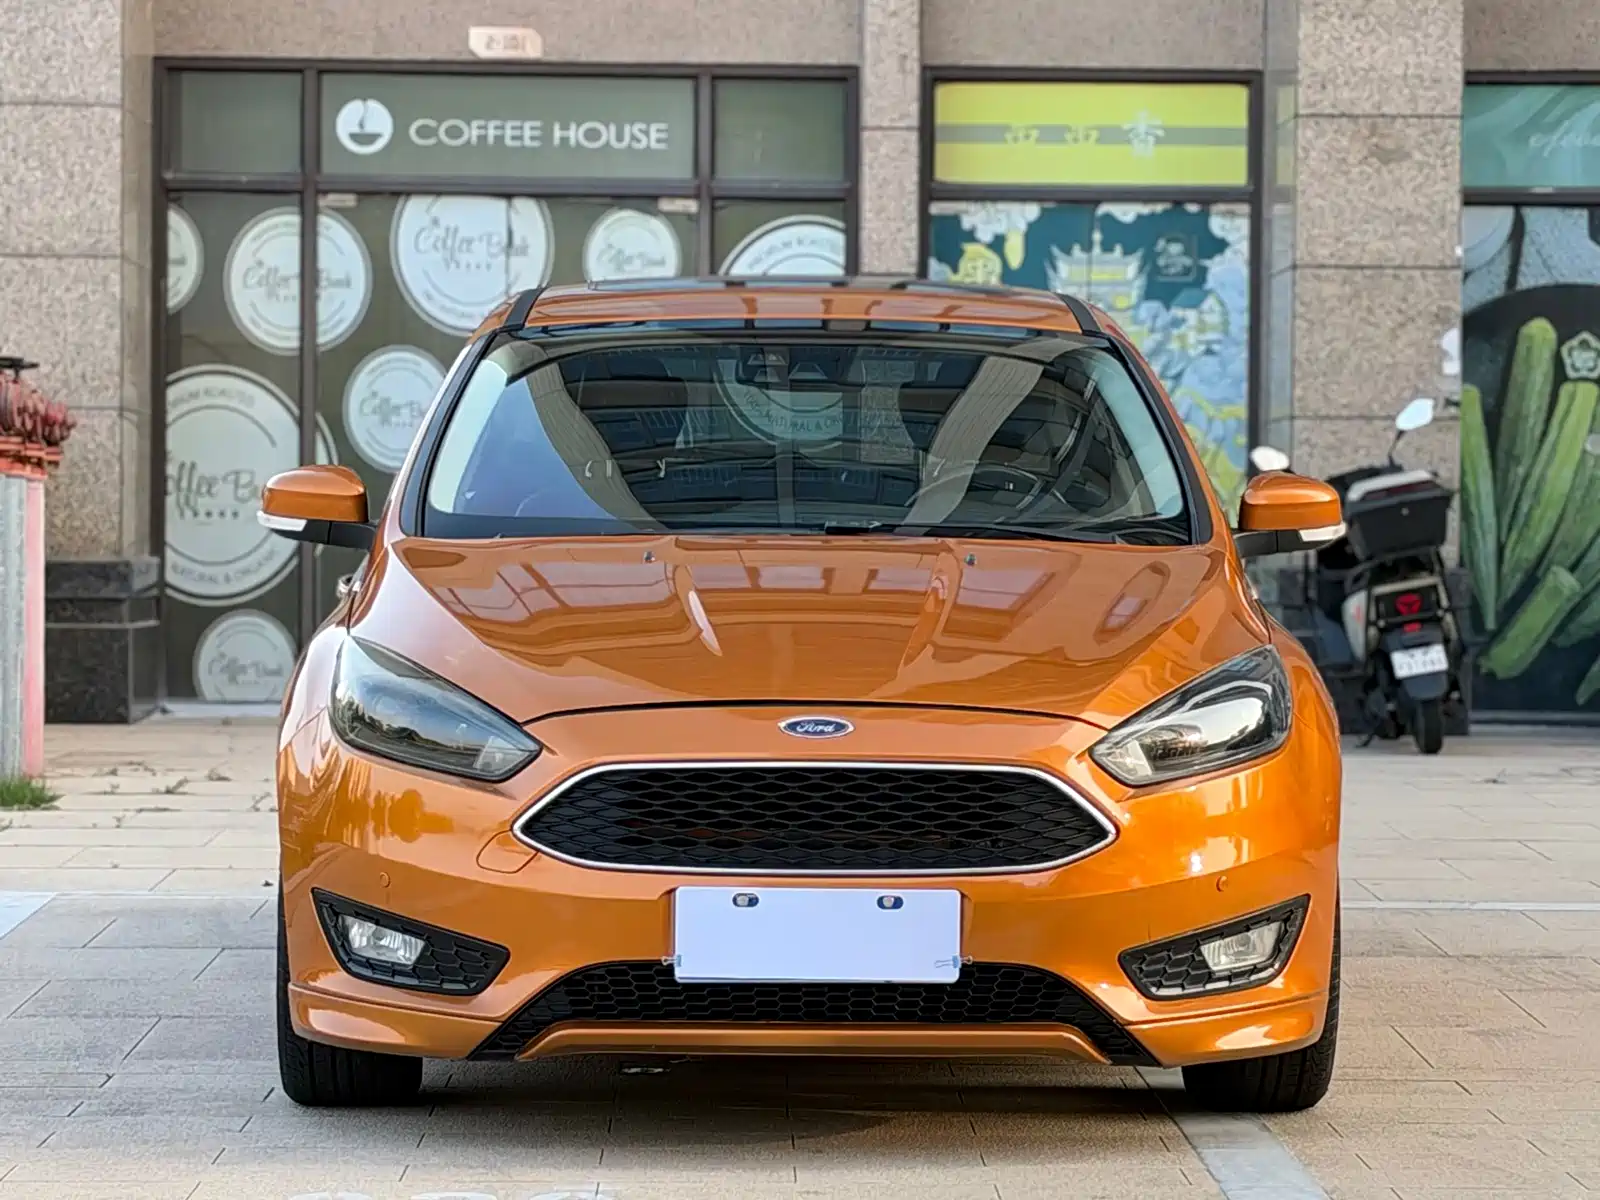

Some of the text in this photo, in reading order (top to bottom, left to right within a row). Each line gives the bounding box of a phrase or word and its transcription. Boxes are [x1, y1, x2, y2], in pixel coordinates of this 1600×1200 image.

[408, 117, 670, 151] COFFEE HOUSE
[413, 216, 476, 271] Coffee
[166, 460, 220, 518] offee
[796, 721, 836, 733] Ford
